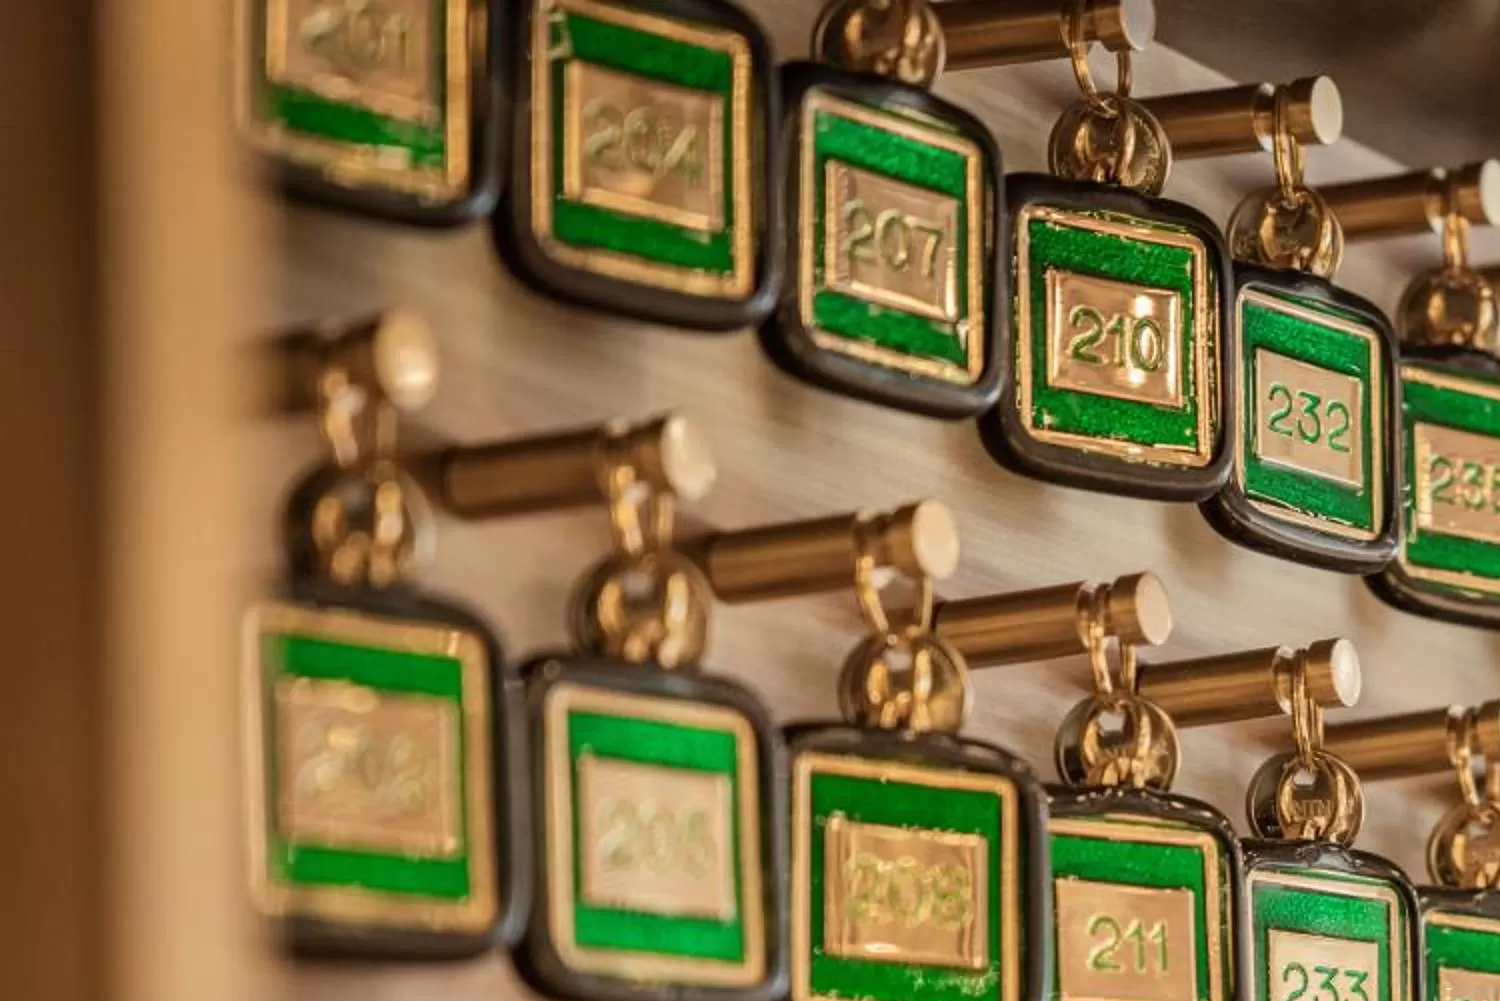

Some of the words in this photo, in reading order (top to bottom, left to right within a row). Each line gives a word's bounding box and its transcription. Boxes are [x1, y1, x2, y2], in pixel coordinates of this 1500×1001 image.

[843, 198, 943, 282] 207
[1069, 306, 1165, 371] 210
[1268, 384, 1351, 452] 232
[1085, 915, 1168, 974] 211
